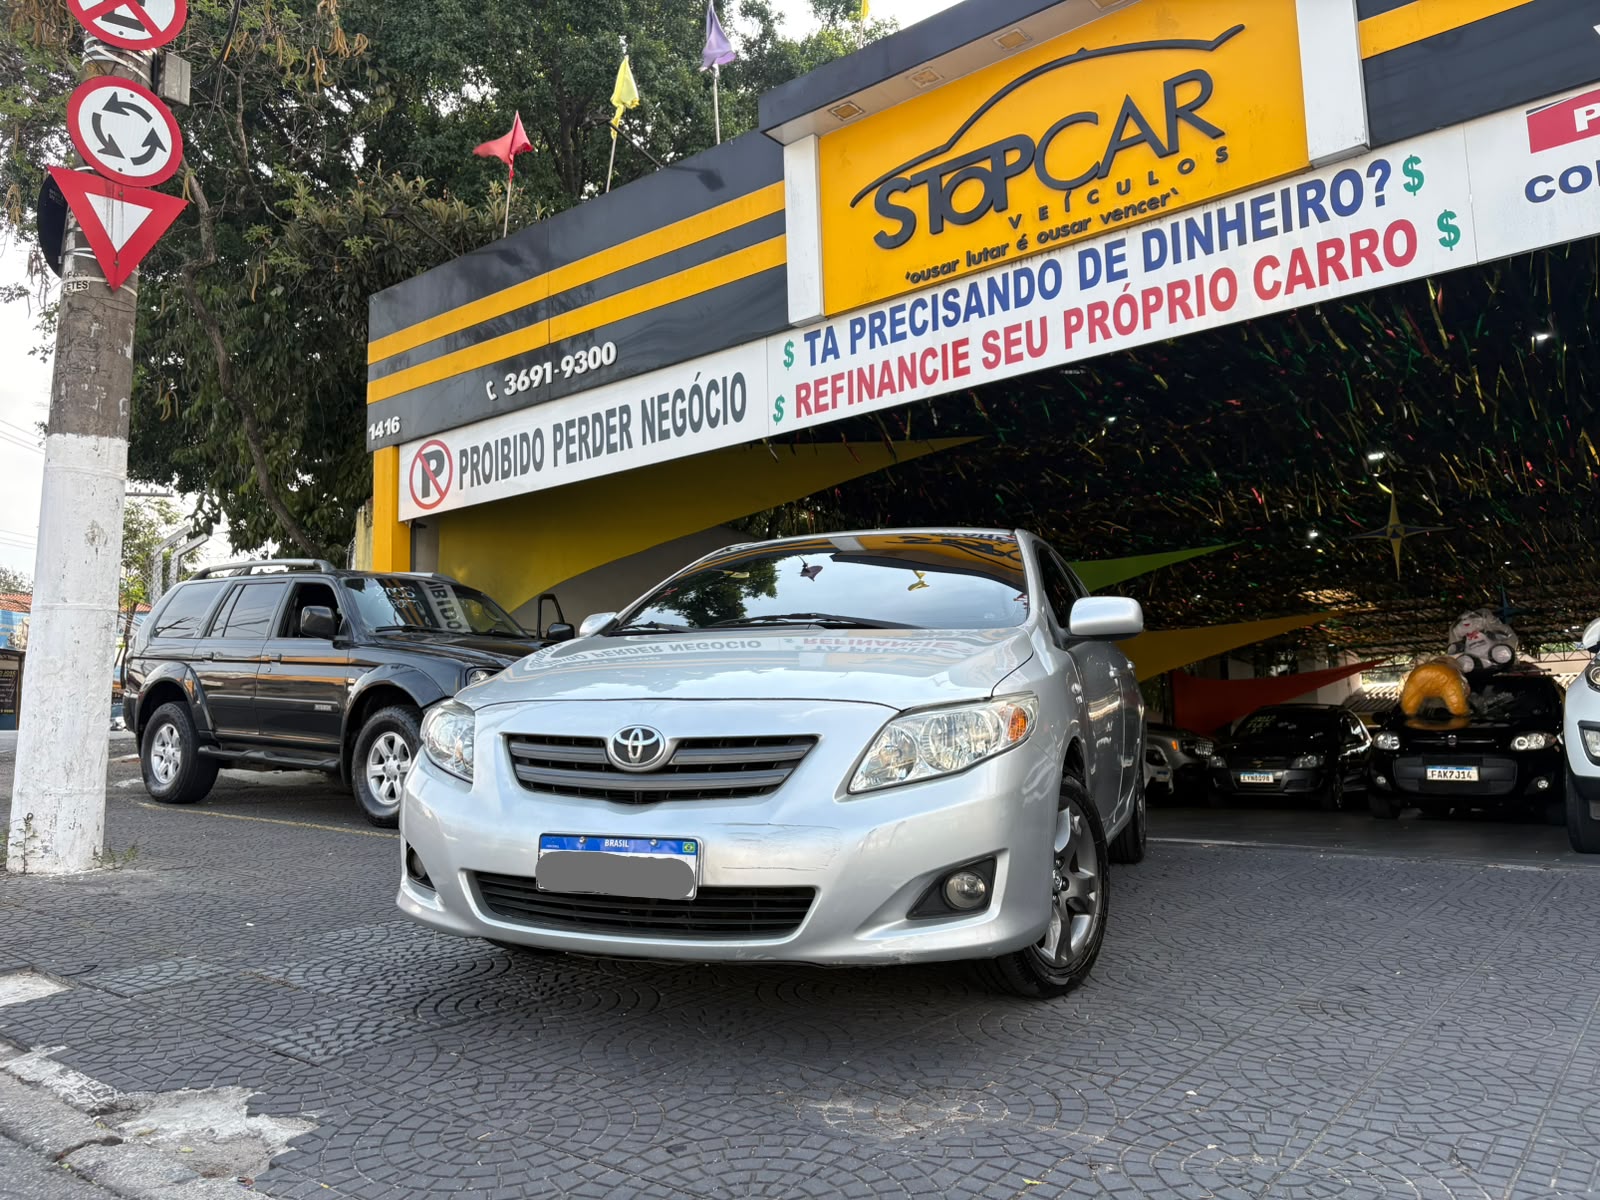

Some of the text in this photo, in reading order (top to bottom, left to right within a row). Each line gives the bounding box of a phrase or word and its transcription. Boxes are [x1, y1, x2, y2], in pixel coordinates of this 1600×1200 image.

[873, 69, 1226, 250] STOPCAR
[1008, 146, 1229, 230] VEÍCULOS
[1525, 160, 1600, 204] CO
[804, 327, 840, 366] TA
[850, 259, 1062, 355] PRECISANDO
[1078, 241, 1129, 290] DE
[1142, 159, 1392, 272] DINHEIRO?
[966, 246, 1010, 268] lutar
[1016, 233, 1029, 251] é
[1037, 216, 1093, 244] ousar
[796, 337, 971, 418] REFINANCIE
[982, 316, 1048, 370] SEU
[1063, 267, 1239, 350] PRÓPRIO
[1253, 219, 1417, 301] CARRO
[503, 341, 618, 398] 3691-9300
[368, 415, 400, 441] 1416
[458, 427, 545, 490] PROIBIDO
[552, 404, 633, 468] PERDER
[641, 371, 748, 446] NEGÓCIO
[1431, 769, 1473, 779] FAK7J14
[604, 838, 630, 848] BRASIL
